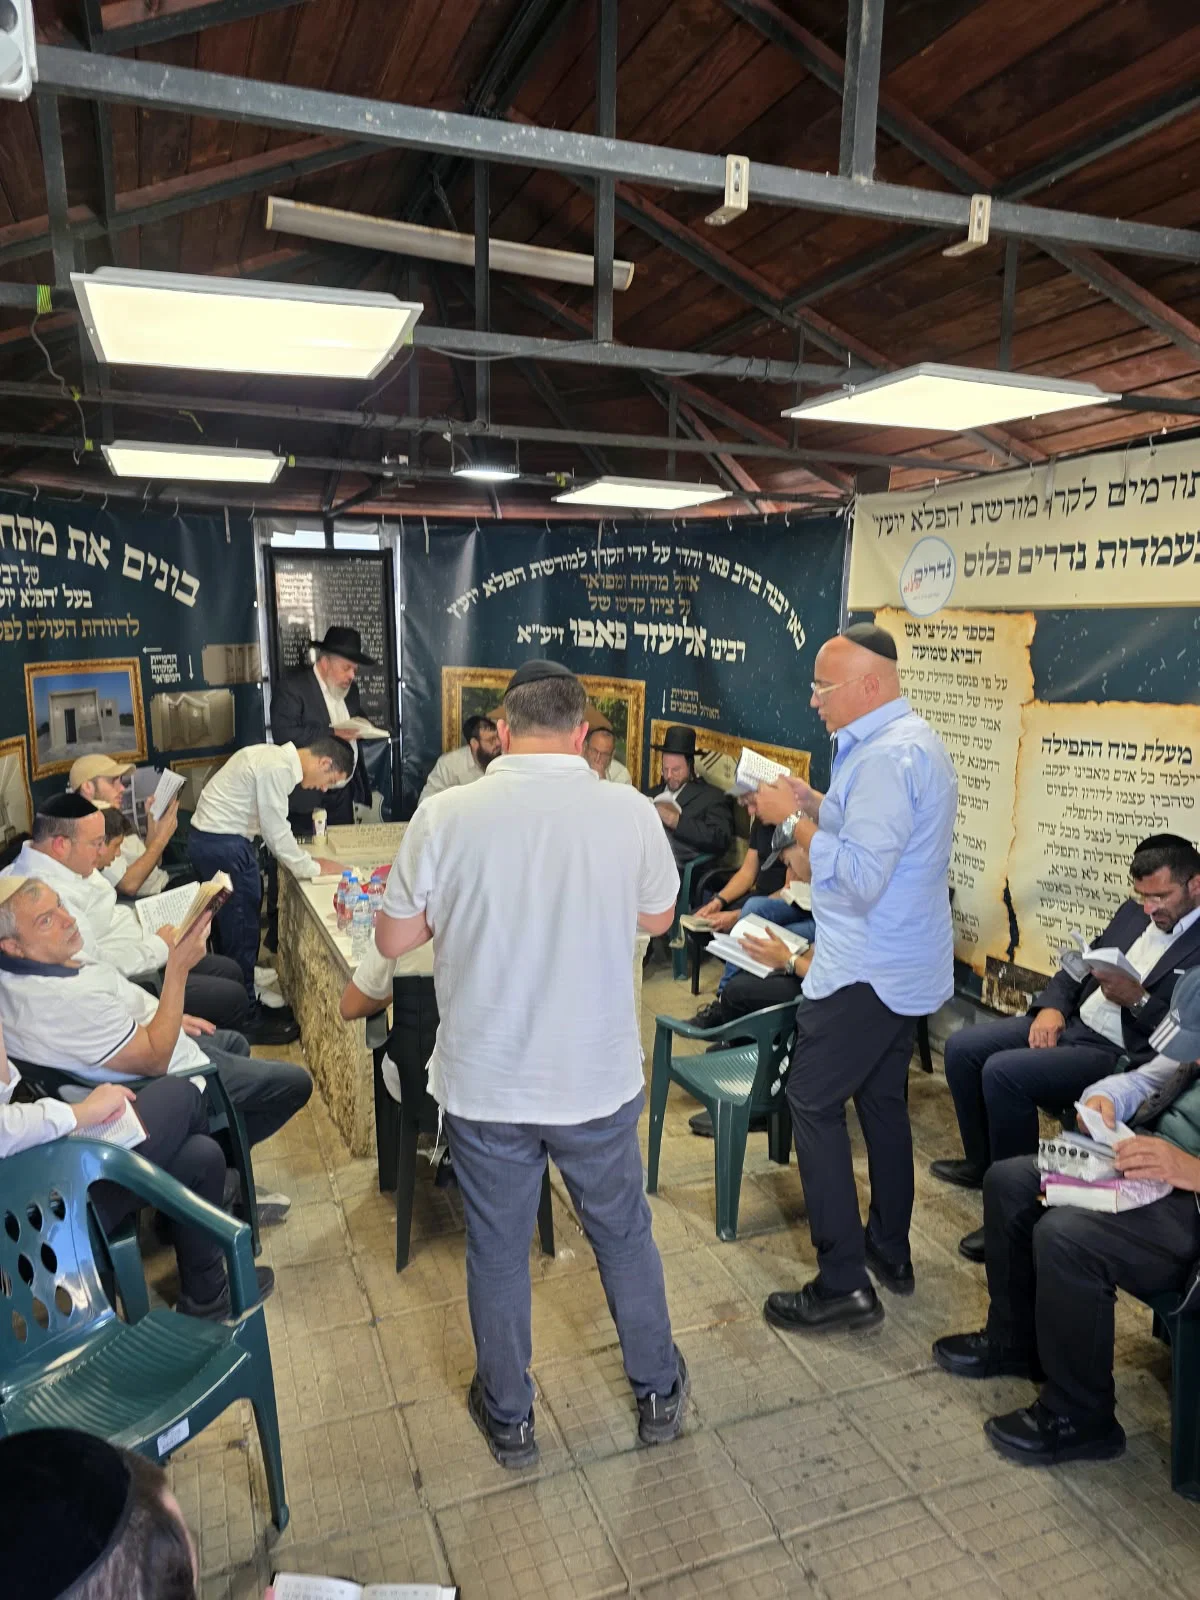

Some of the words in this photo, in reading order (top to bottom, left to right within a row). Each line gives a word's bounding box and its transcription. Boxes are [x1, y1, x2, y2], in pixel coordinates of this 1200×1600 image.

[1046, 476, 1097, 520] לקרן
[970, 494, 1038, 526] מורשת
[67, 524, 110, 570] את
[591, 546, 624, 568] הקרן
[627, 545, 647, 562] ידי
[651, 540, 671, 565] על
[529, 546, 587, 580] למורשת
[675, 546, 703, 569] והדר
[706, 551, 730, 579] פאר
[963, 541, 1012, 578] פלוס
[1018, 541, 1087, 575] נדרים
[21, 559, 39, 585] של
[122, 543, 200, 608] בונים
[731, 561, 762, 595] ברוב
[913, 556, 952, 583] נדרים
[482, 566, 527, 599] הפלא
[580, 573, 627, 590] ומפואר
[630, 573, 669, 594] מרווח
[672, 569, 700, 592] אוהל
[62, 583, 93, 608] בעל
[446, 587, 479, 620] יועץ
[588, 591, 611, 612] של
[678, 594, 691, 616] על
[762, 580, 789, 615] יבנה
[615, 596, 646, 616] קדשו
[649, 596, 675, 616] ציון
[0, 612, 23, 641] לפ
[26, 612, 77, 640] העולים
[81, 612, 140, 639] לרווחת
[516, 623, 565, 646] זיע"א
[569, 617, 628, 650] פאפו
[786, 607, 806, 651] כאן
[904, 622, 921, 638] אש
[923, 619, 958, 641] מליצי
[962, 624, 995, 643] בספר
[633, 615, 707, 659] אליעזר
[710, 637, 746, 663] רבינו
[911, 642, 948, 662] שמועה
[950, 646, 983, 665] הביא
[956, 672, 979, 689] פנקס
[981, 675, 992, 690] פי
[994, 673, 1008, 691] על
[911, 688, 941, 703] שקודם
[966, 691, 981, 708] של
[925, 708, 956, 724] השמים
[958, 713, 978, 728] שמן
[980, 716, 1002, 732] אמר
[941, 731, 971, 747] שיהיה
[972, 735, 992, 751] שנה
[1041, 732, 1103, 758] התפילה
[1107, 739, 1138, 761] כוח
[1140, 737, 1193, 765] מעלת
[967, 755, 1001, 774] רחמנא
[1073, 765, 1110, 781] מאבינו
[961, 774, 991, 792] ליפטר
[1113, 769, 1137, 783] אדם
[1140, 767, 1155, 785] כל
[1046, 781, 1078, 798] ולפיוס
[1081, 785, 1113, 802] לדורון
[1116, 790, 1146, 805] עצמו
[1150, 793, 1195, 809] שהבין
[1037, 821, 1057, 836] צרה
[1106, 810, 1169, 829] ולמלחמה
[1059, 821, 1080, 840] מכל
[1083, 825, 1112, 844] לנצל
[953, 851, 986, 872] כשהוא
[1083, 847, 1134, 867] שתדלות
[1081, 865, 1099, 881] לא
[1103, 871, 1122, 885] הא
[1036, 879, 1072, 896] כאשר
[1074, 883, 1101, 900] אלה
[1102, 886, 1121, 904] כל
